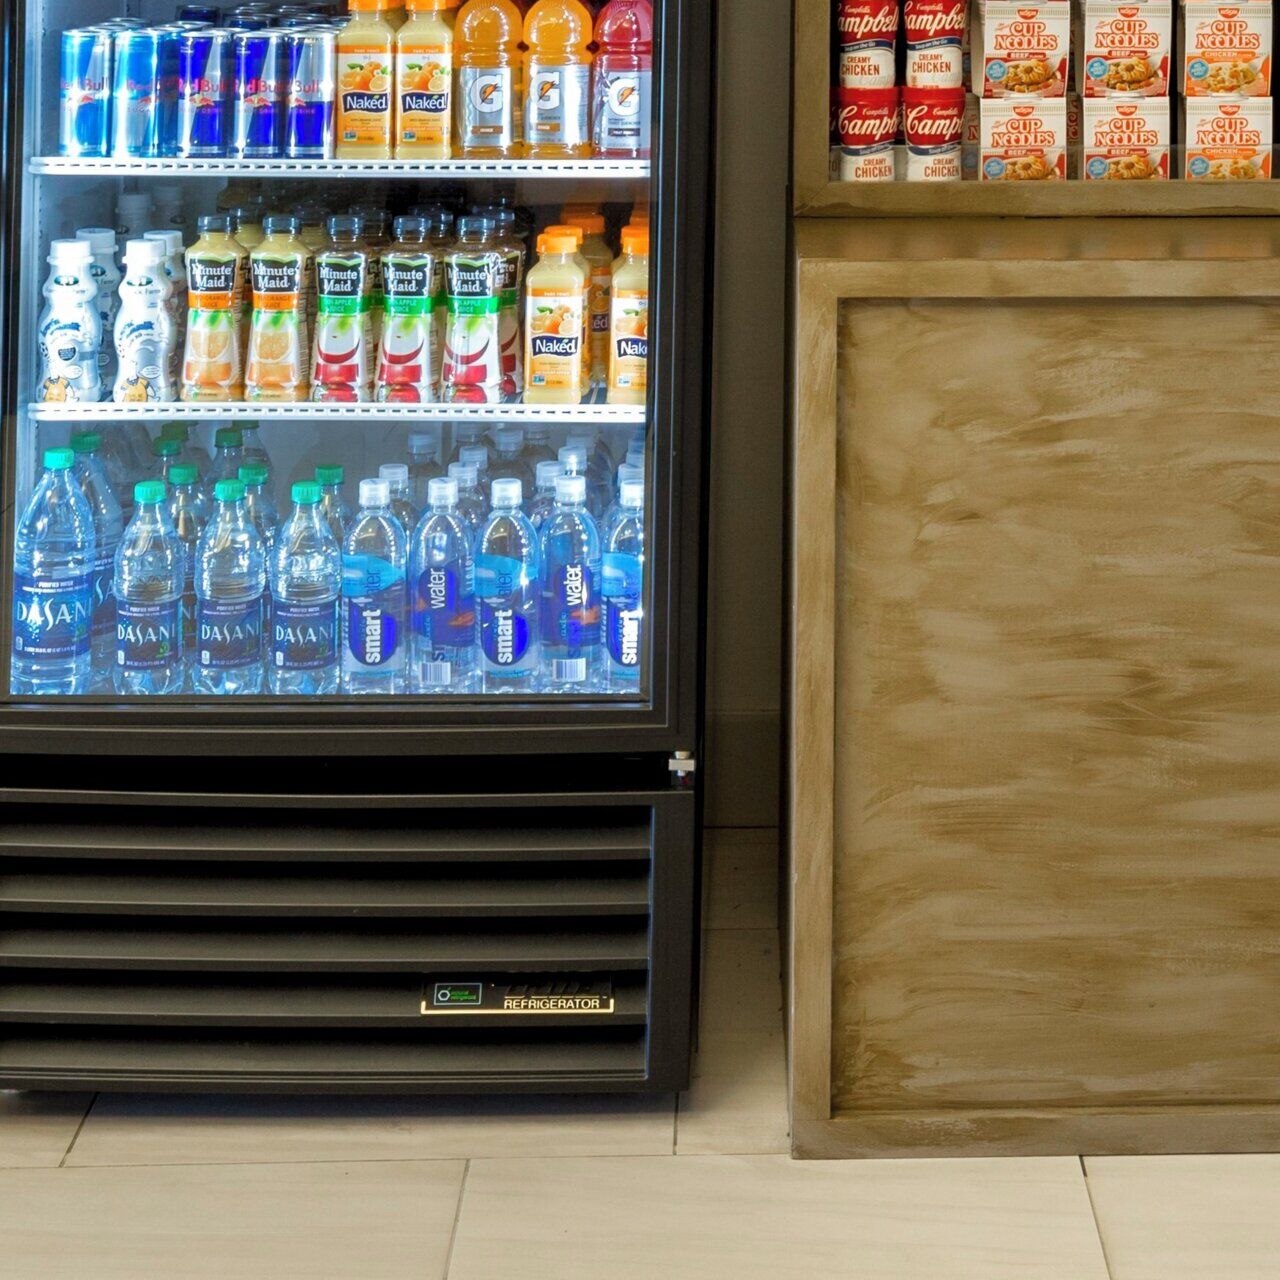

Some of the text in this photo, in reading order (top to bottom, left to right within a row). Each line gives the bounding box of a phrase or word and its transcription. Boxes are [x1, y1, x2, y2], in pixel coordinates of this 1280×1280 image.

[847, 56, 871, 64] CREAMY
[918, 54, 943, 62] CREAMY
[912, 62, 951, 73] CHICKEN
[470, 74, 503, 113] G
[1110, 118, 1145, 133] CUP
[1211, 118, 1248, 133] CUP
[992, 131, 1055, 147] NOODLES
[1095, 131, 1158, 147] NOODLES
[1196, 130, 1260, 146] NOODLES
[384, 267, 423, 280] Minute
[448, 267, 486, 280] Minute
[387, 279, 418, 292] Maid
[563, 564, 582, 607] water
[118, 623, 175, 645] DASANI
[201, 622, 260, 644] DASANI
[275, 623, 333, 647] DASANI
[362, 609, 381, 663] smart
[495, 609, 513, 663] smart
[504, 999, 600, 1009] REFRIGERATOR
